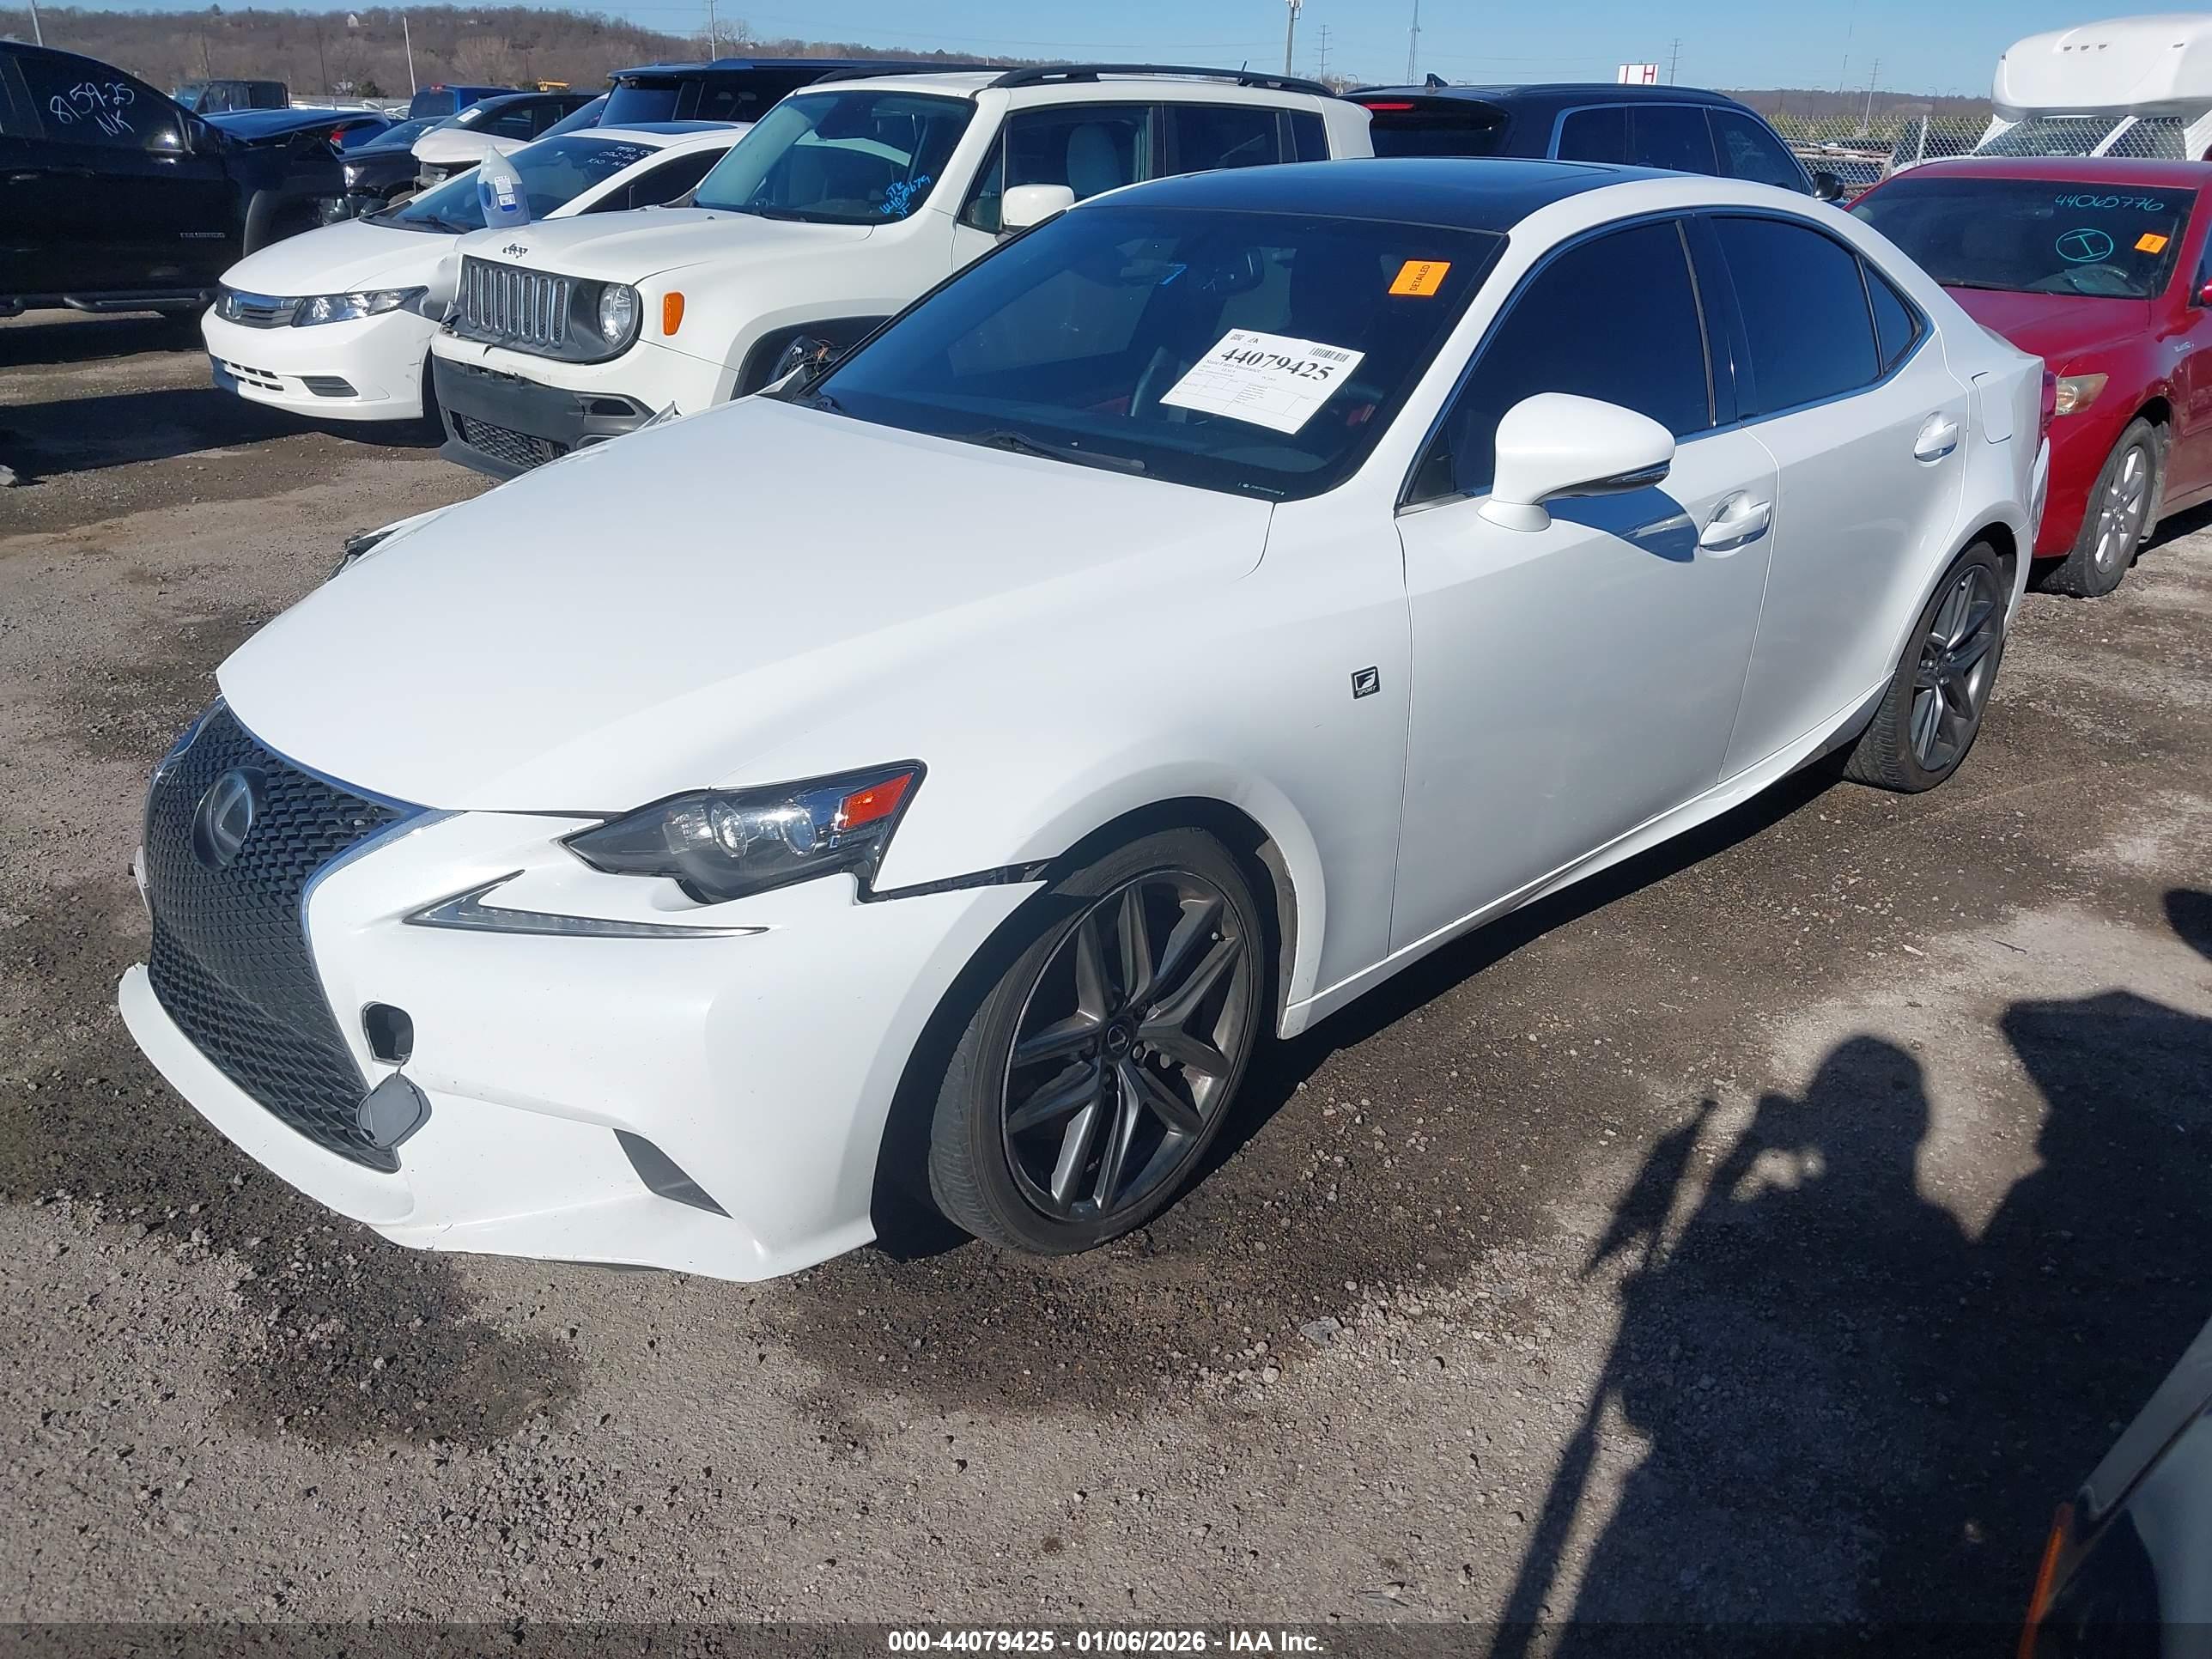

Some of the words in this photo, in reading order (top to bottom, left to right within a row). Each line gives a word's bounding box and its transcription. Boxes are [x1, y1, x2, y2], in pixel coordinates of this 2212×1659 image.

[50, 82, 135, 124] 8159-25
[94, 109, 135, 137] NK
[2054, 193, 2165, 211] 44065776
[1409, 264, 1431, 291] DETAILED
[1220, 347, 1335, 380] 44079425
